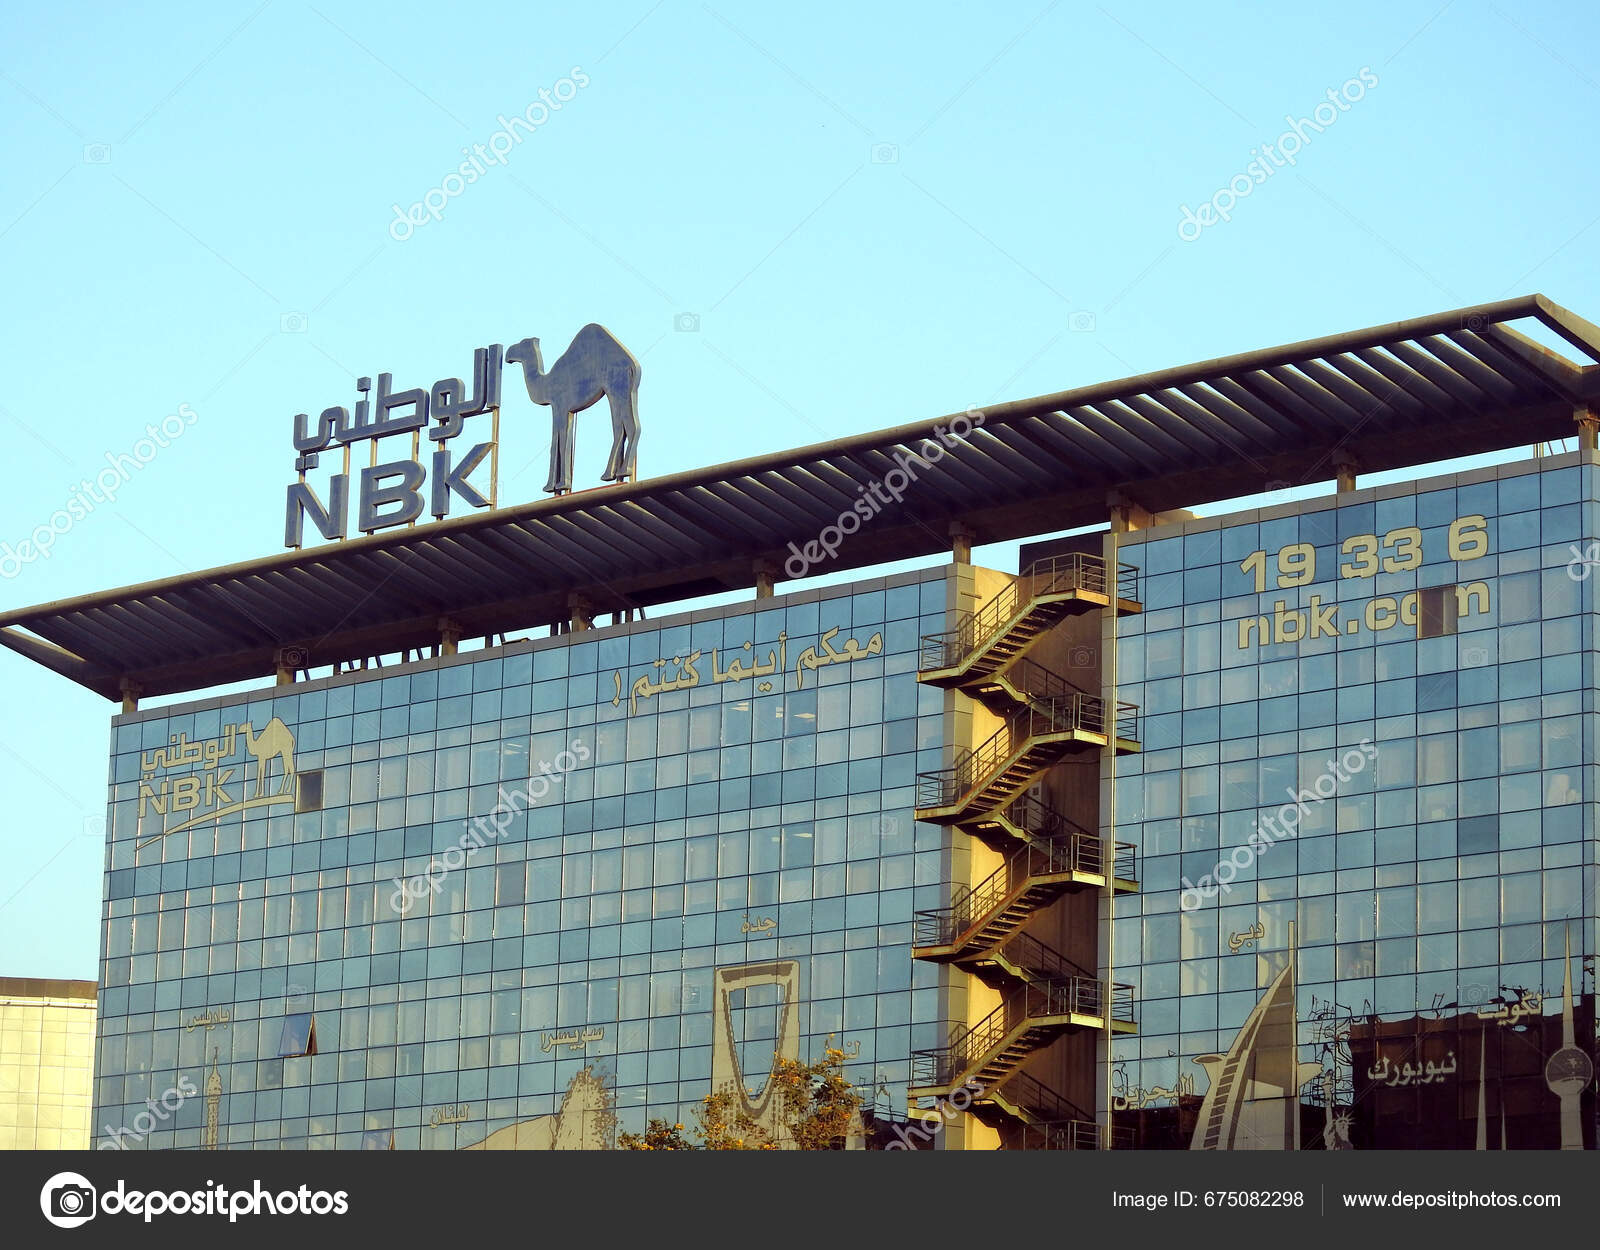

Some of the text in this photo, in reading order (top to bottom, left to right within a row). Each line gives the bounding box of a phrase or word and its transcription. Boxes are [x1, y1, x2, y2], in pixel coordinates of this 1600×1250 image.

[293, 343, 503, 471] الوطني
[284, 441, 497, 548] NBK
[1240, 514, 1489, 593] 19 33 6
[711, 630, 789, 692] أينما
[796, 625, 884, 690] معكم
[141, 723, 237, 780] الوطني
[138, 768, 236, 818] NBK
[1228, 920, 1266, 955] دبي
